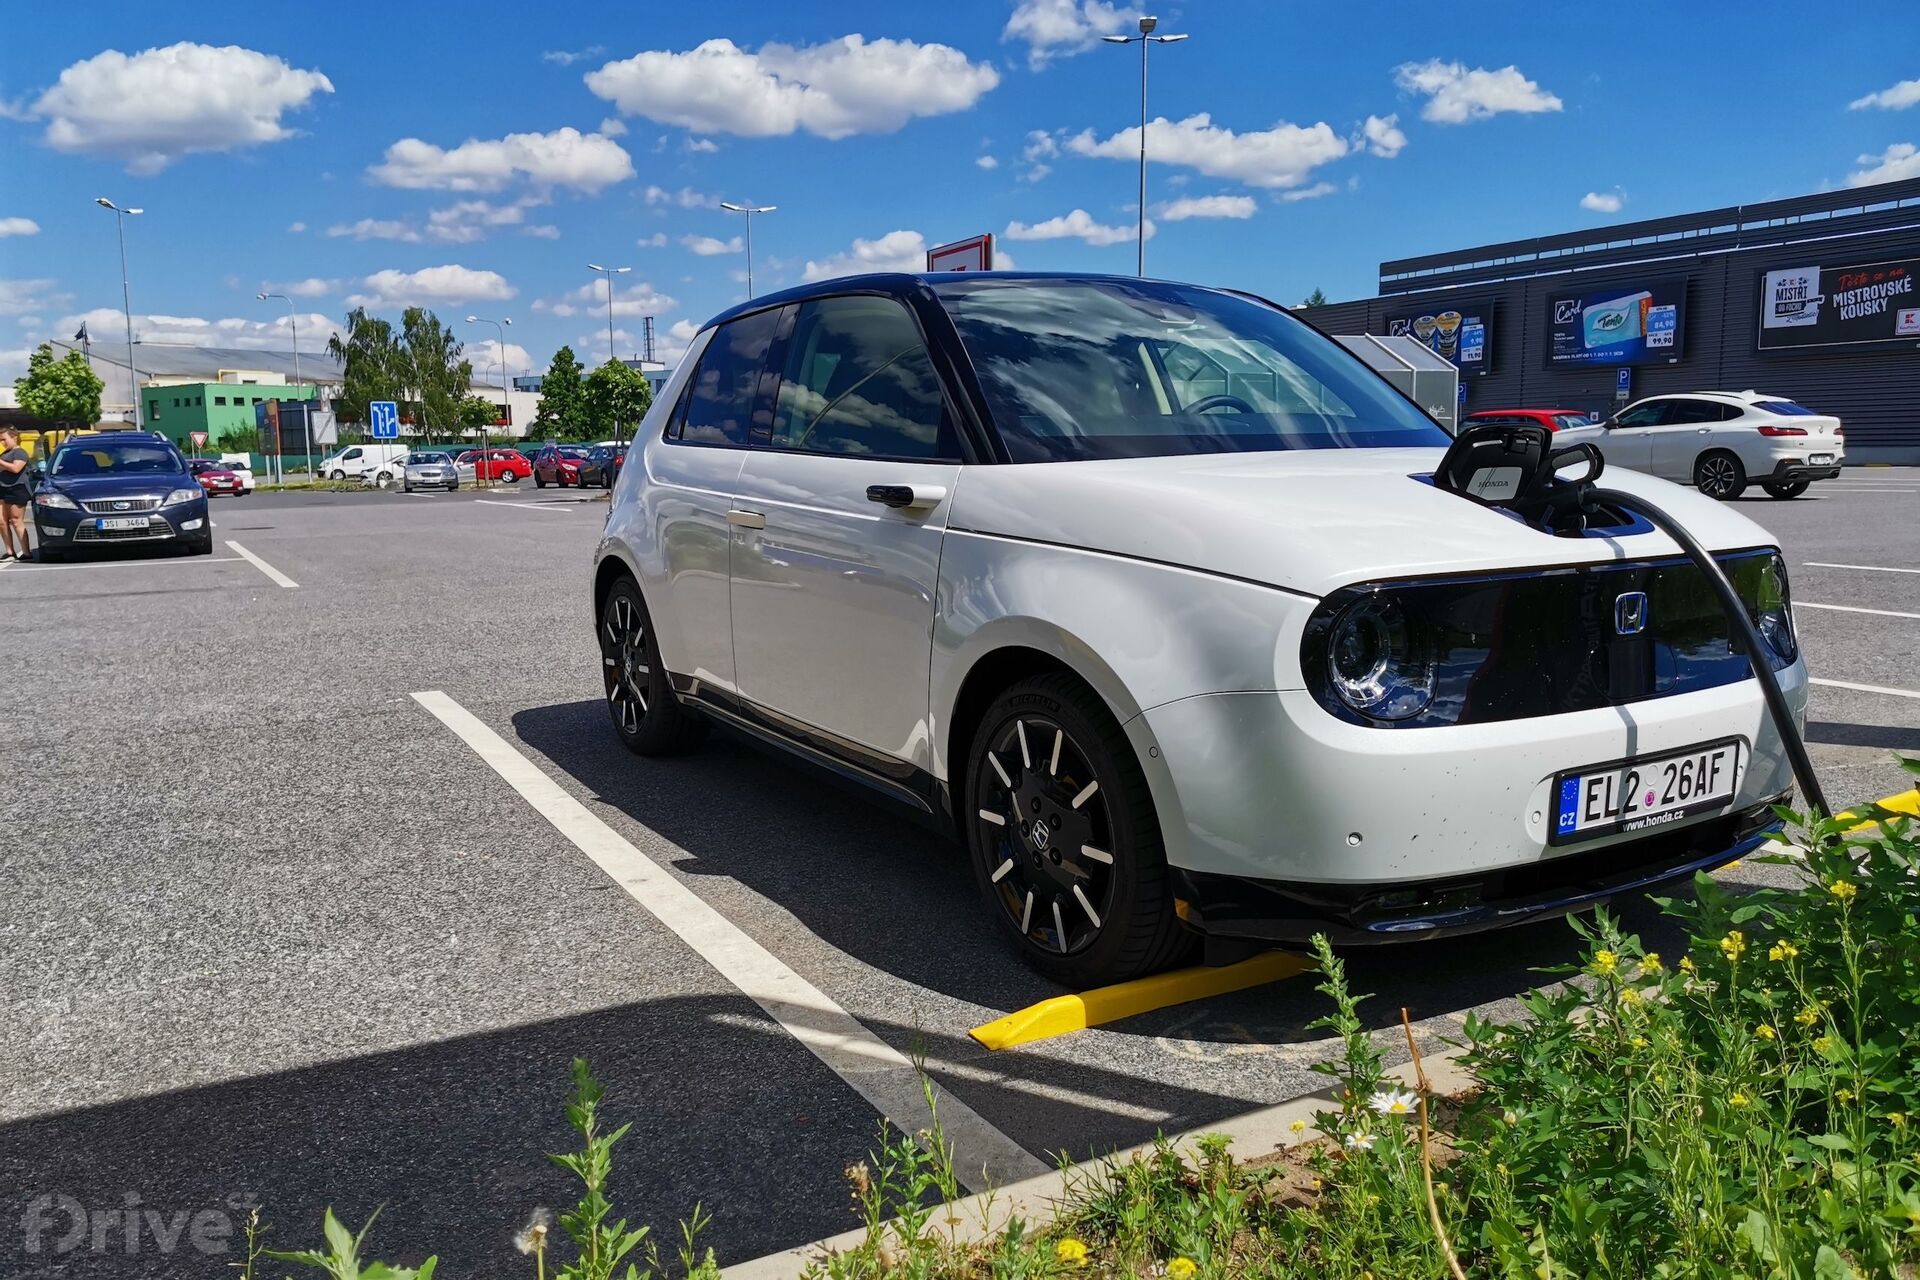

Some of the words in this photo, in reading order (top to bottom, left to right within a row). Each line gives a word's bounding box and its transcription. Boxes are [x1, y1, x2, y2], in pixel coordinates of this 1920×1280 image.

[1833, 275, 1912, 308] MISTROVSKÉ
[1557, 300, 1582, 322] Card
[1840, 297, 1888, 320] KOUSKY
[1598, 313, 1623, 328] Tento
[1620, 371, 1627, 383] P
[126, 519, 145, 527] 3464
[1584, 770, 1640, 822] EL2
[1660, 751, 1725, 805] 26AF
[1559, 812, 1575, 827] CZ
[1622, 810, 1684, 832] www.honda.cz
